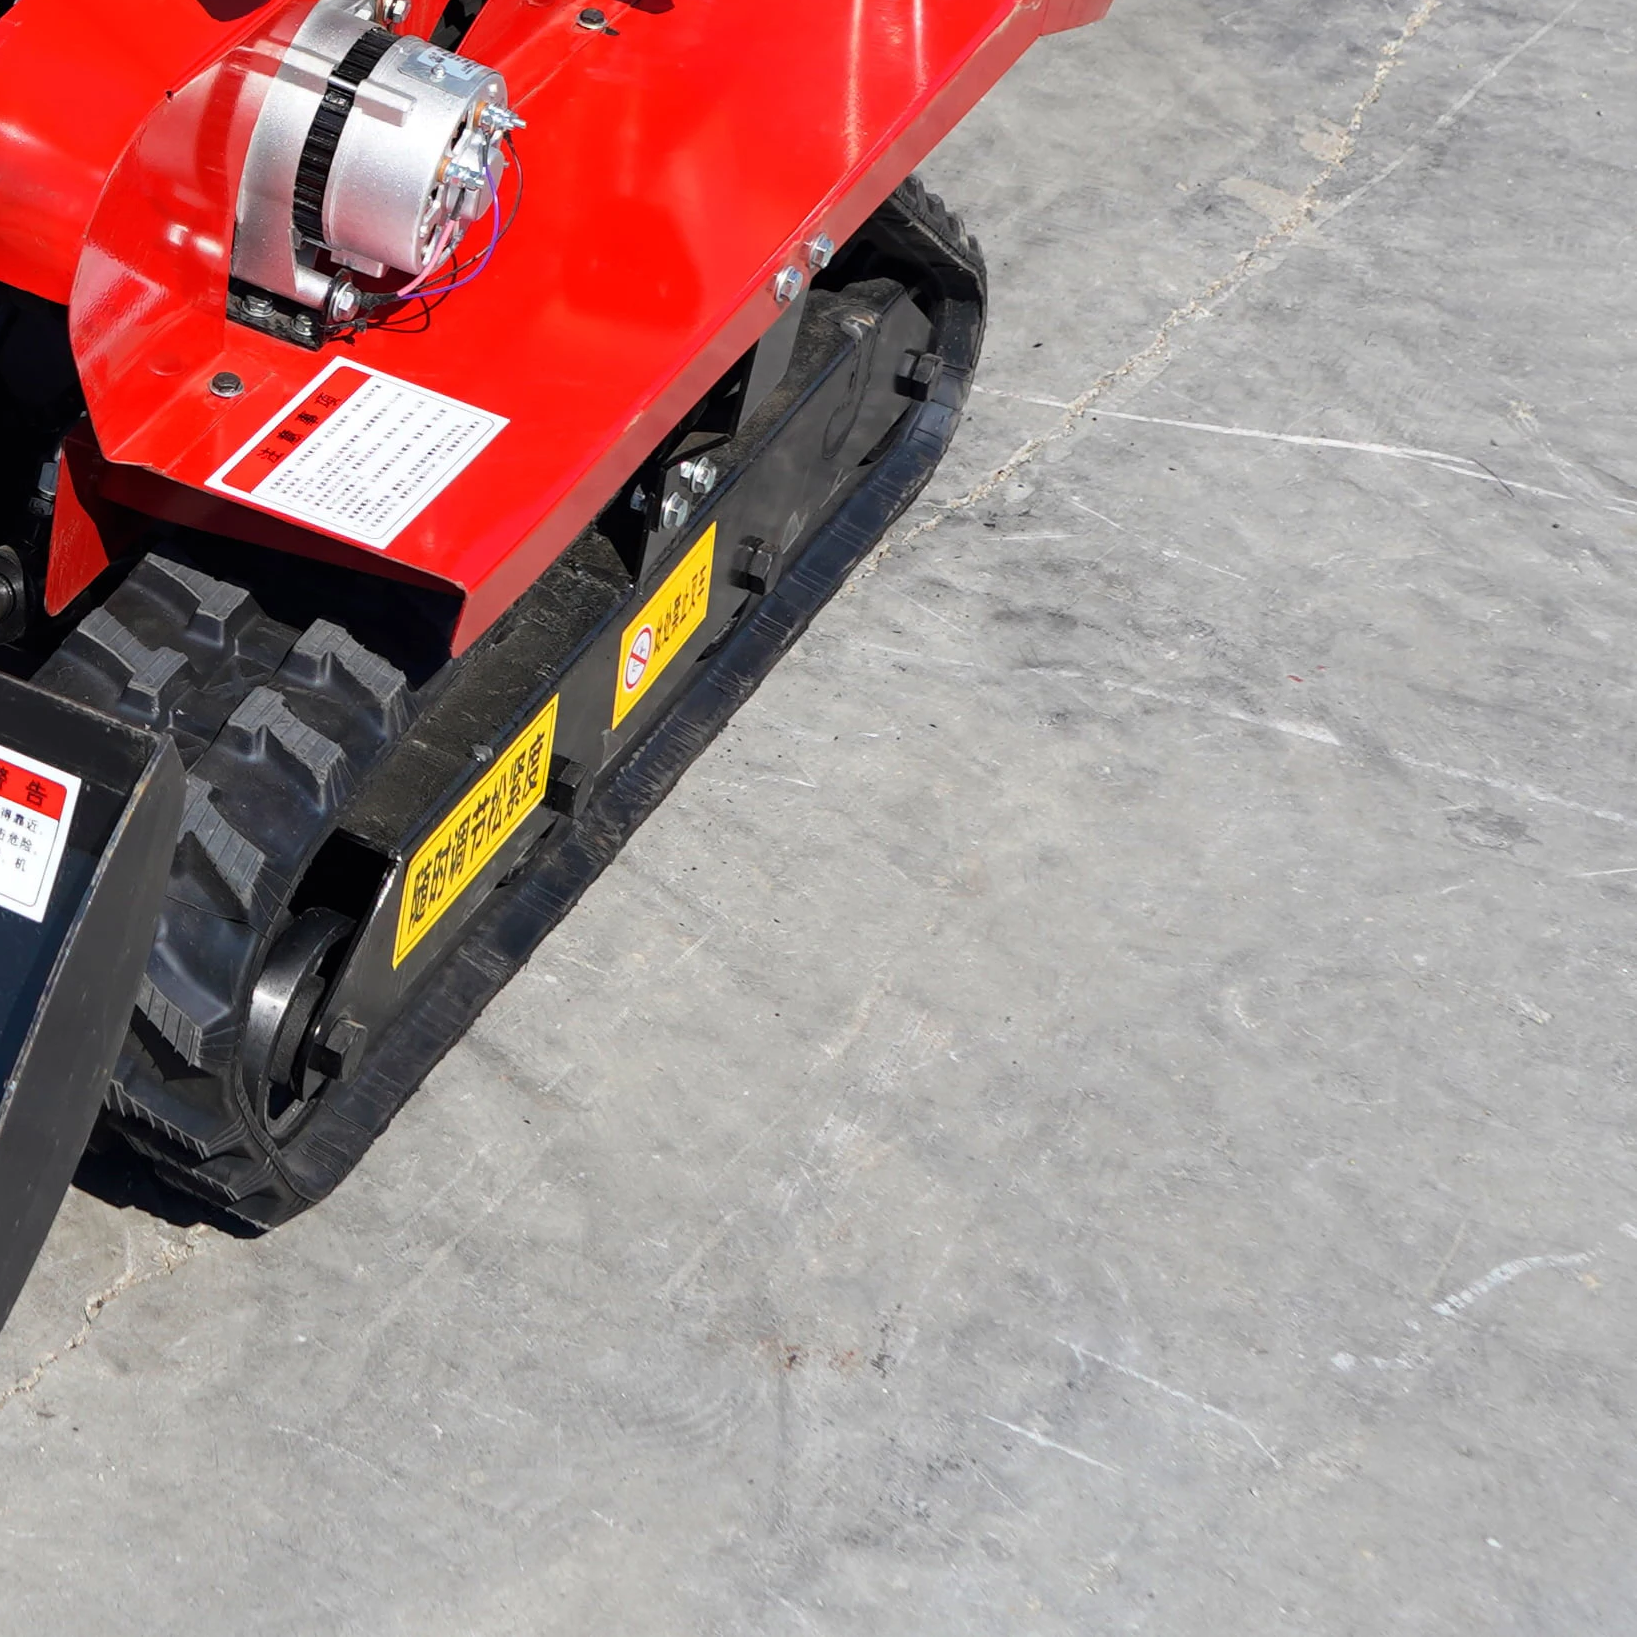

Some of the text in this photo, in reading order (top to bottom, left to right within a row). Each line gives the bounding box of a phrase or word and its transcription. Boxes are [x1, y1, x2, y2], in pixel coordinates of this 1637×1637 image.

[256, 392, 342, 464] 注意事项
[407, 731, 545, 935] 随时调节松紧度
